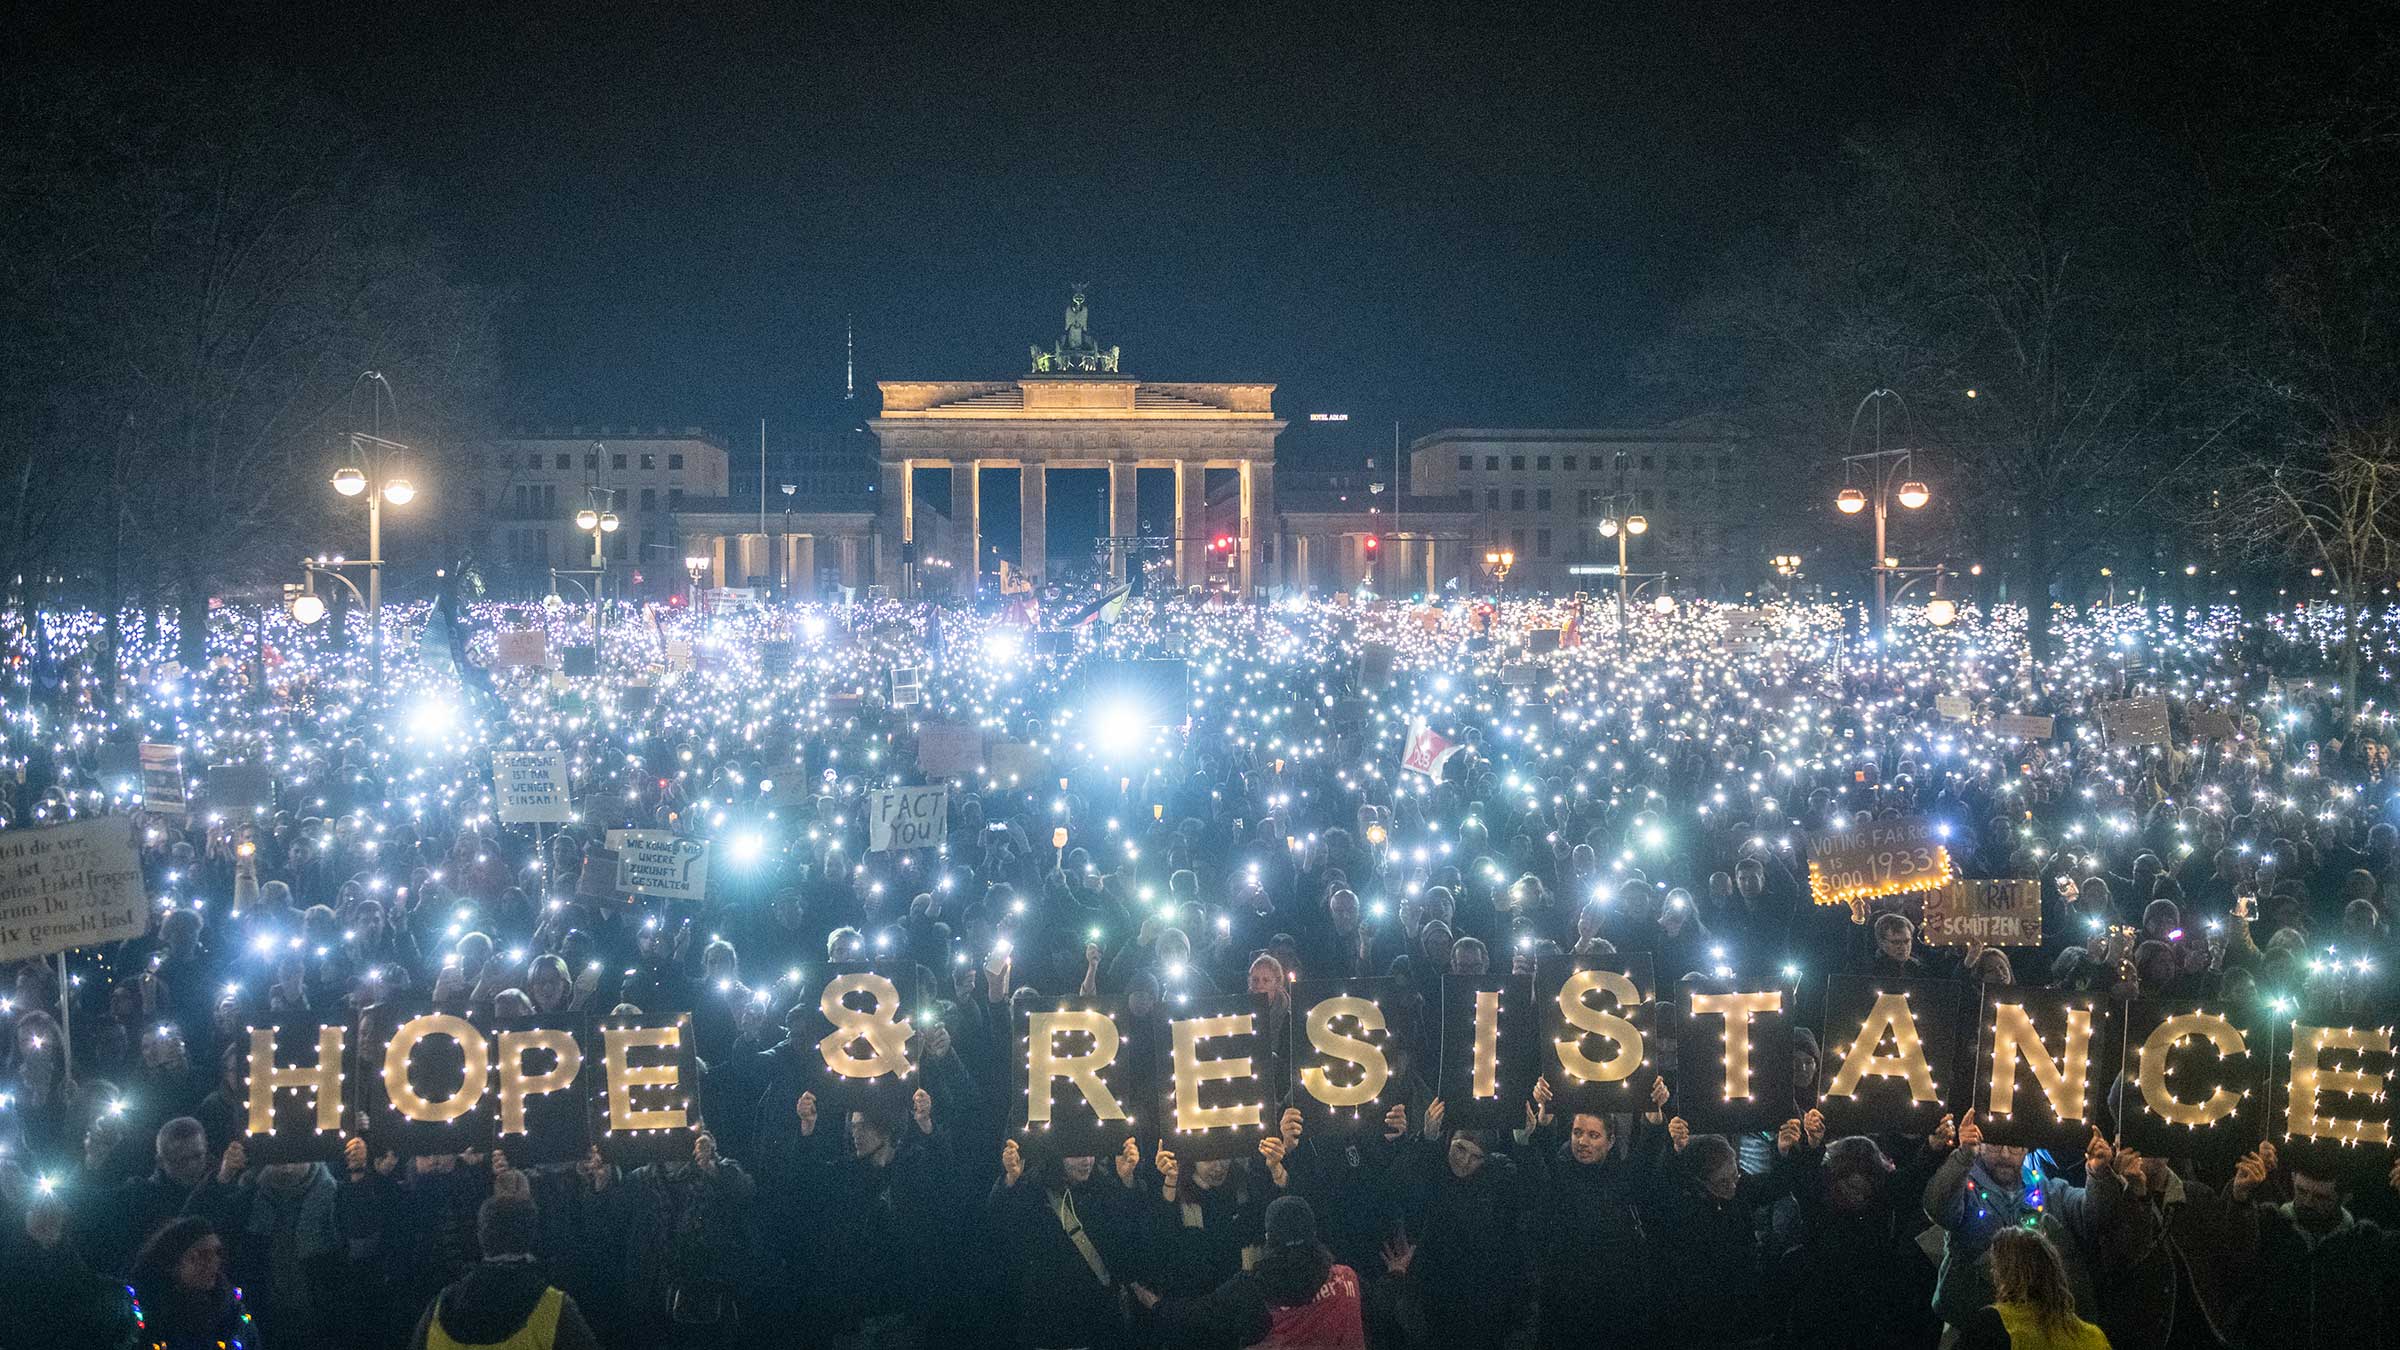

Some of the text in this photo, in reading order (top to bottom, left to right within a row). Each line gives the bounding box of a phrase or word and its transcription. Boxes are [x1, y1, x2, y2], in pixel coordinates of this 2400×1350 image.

[882, 792, 944, 822] FACT
[626, 838, 644, 849] WIE
[1811, 823, 1936, 856] VOTING FAR RIG
[629, 864, 677, 877] ZUKUNFT
[639, 852, 676, 865] UNSERE
[1866, 847, 1933, 882] 1933
[631, 876, 690, 892] GESTALTEN
[1943, 913, 2019, 937] SCHÜTZEN
[246, 969, 2397, 1146] HOPE & RESISTANCE
